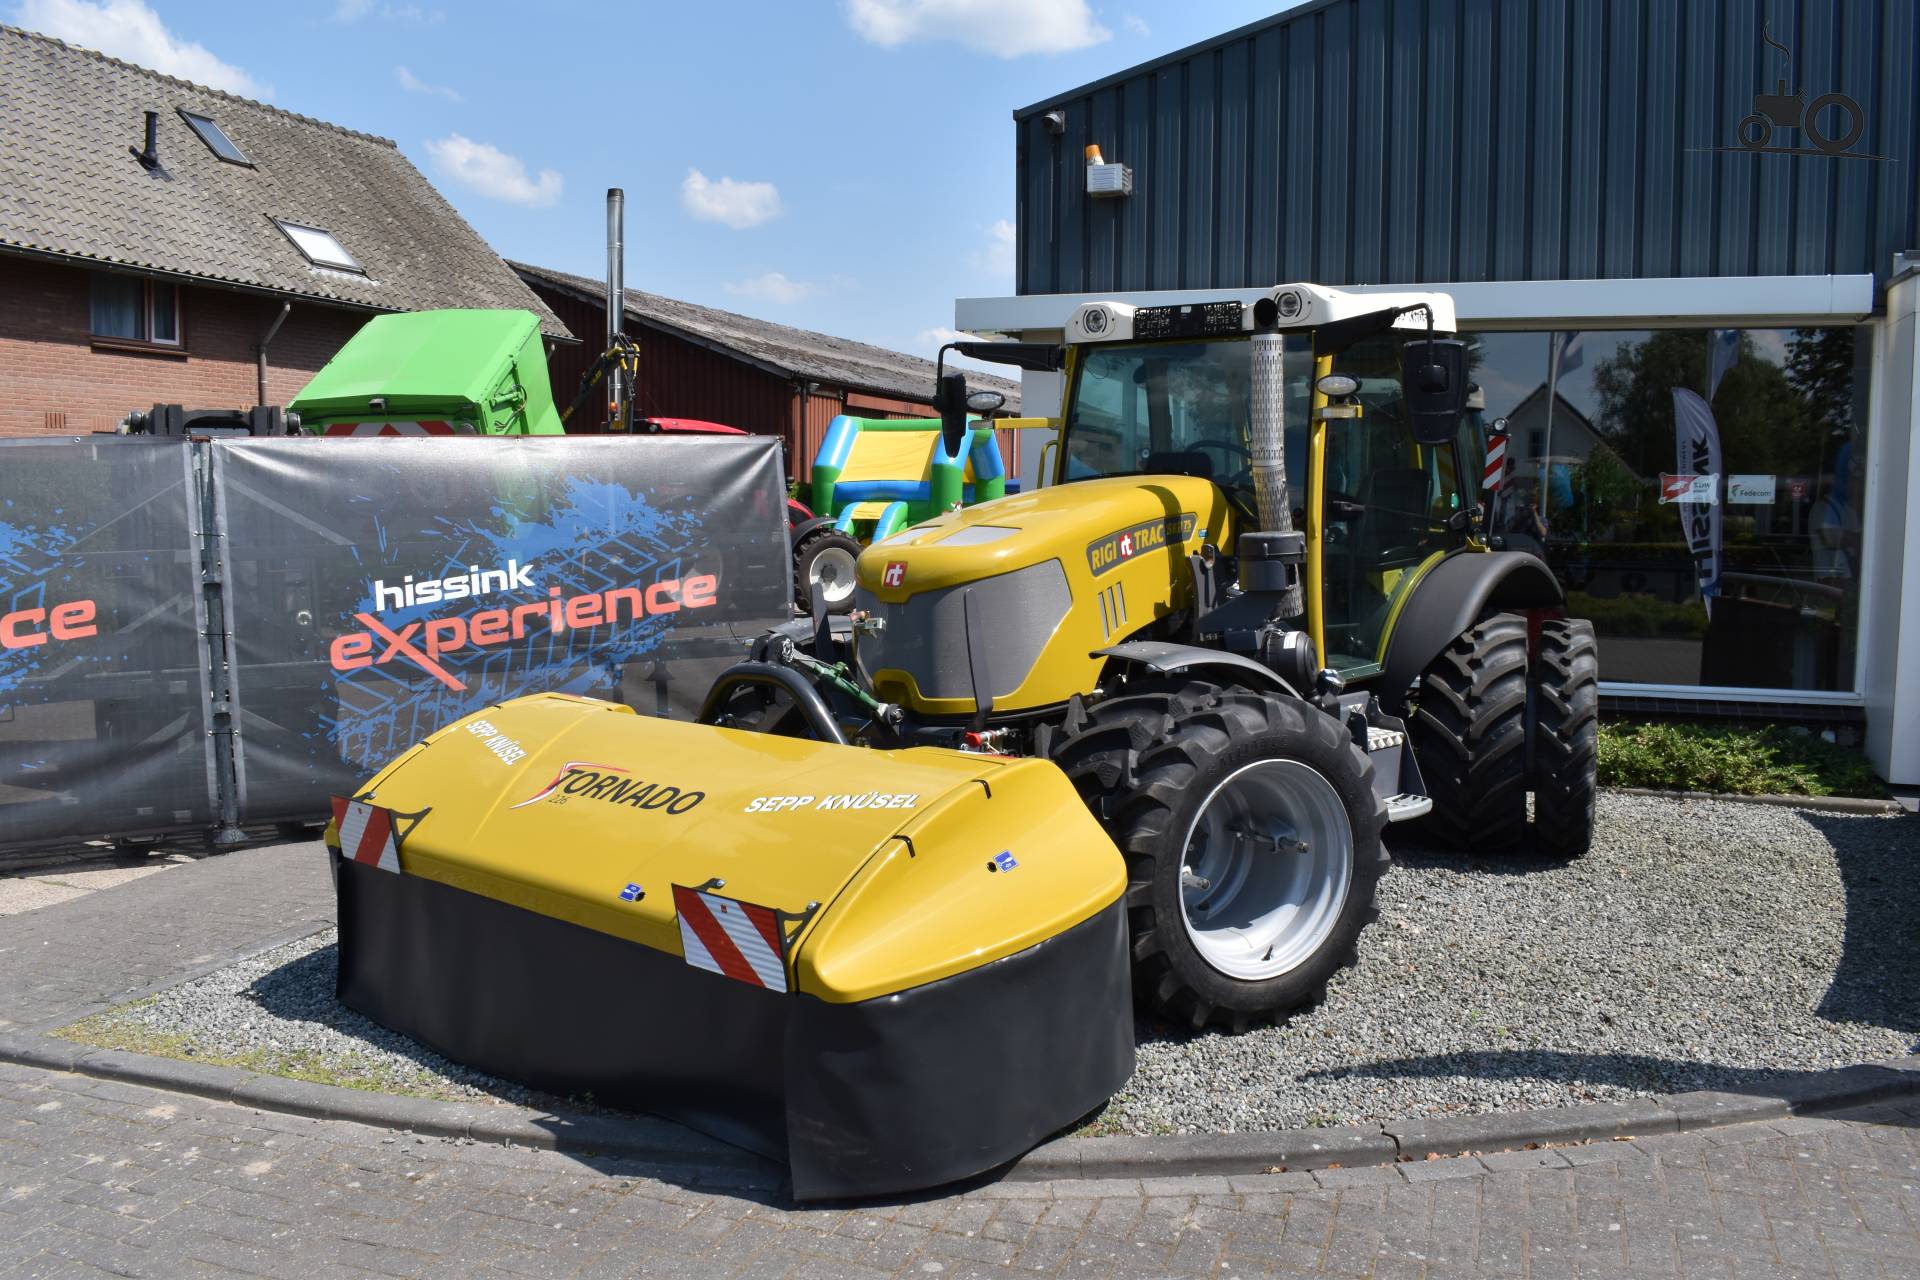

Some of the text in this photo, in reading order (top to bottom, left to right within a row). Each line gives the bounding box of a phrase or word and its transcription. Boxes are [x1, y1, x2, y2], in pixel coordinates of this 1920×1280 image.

[1740, 489, 1771, 497] Fedecom
[1091, 541, 1117, 571] RIGI
[1134, 524, 1165, 550] TRAC
[375, 559, 535, 611] hissink
[465, 720, 528, 765] SEPP KNÜSEL
[548, 768, 706, 815] TORNADO
[744, 791, 921, 813] SEPP KNÜSEL
